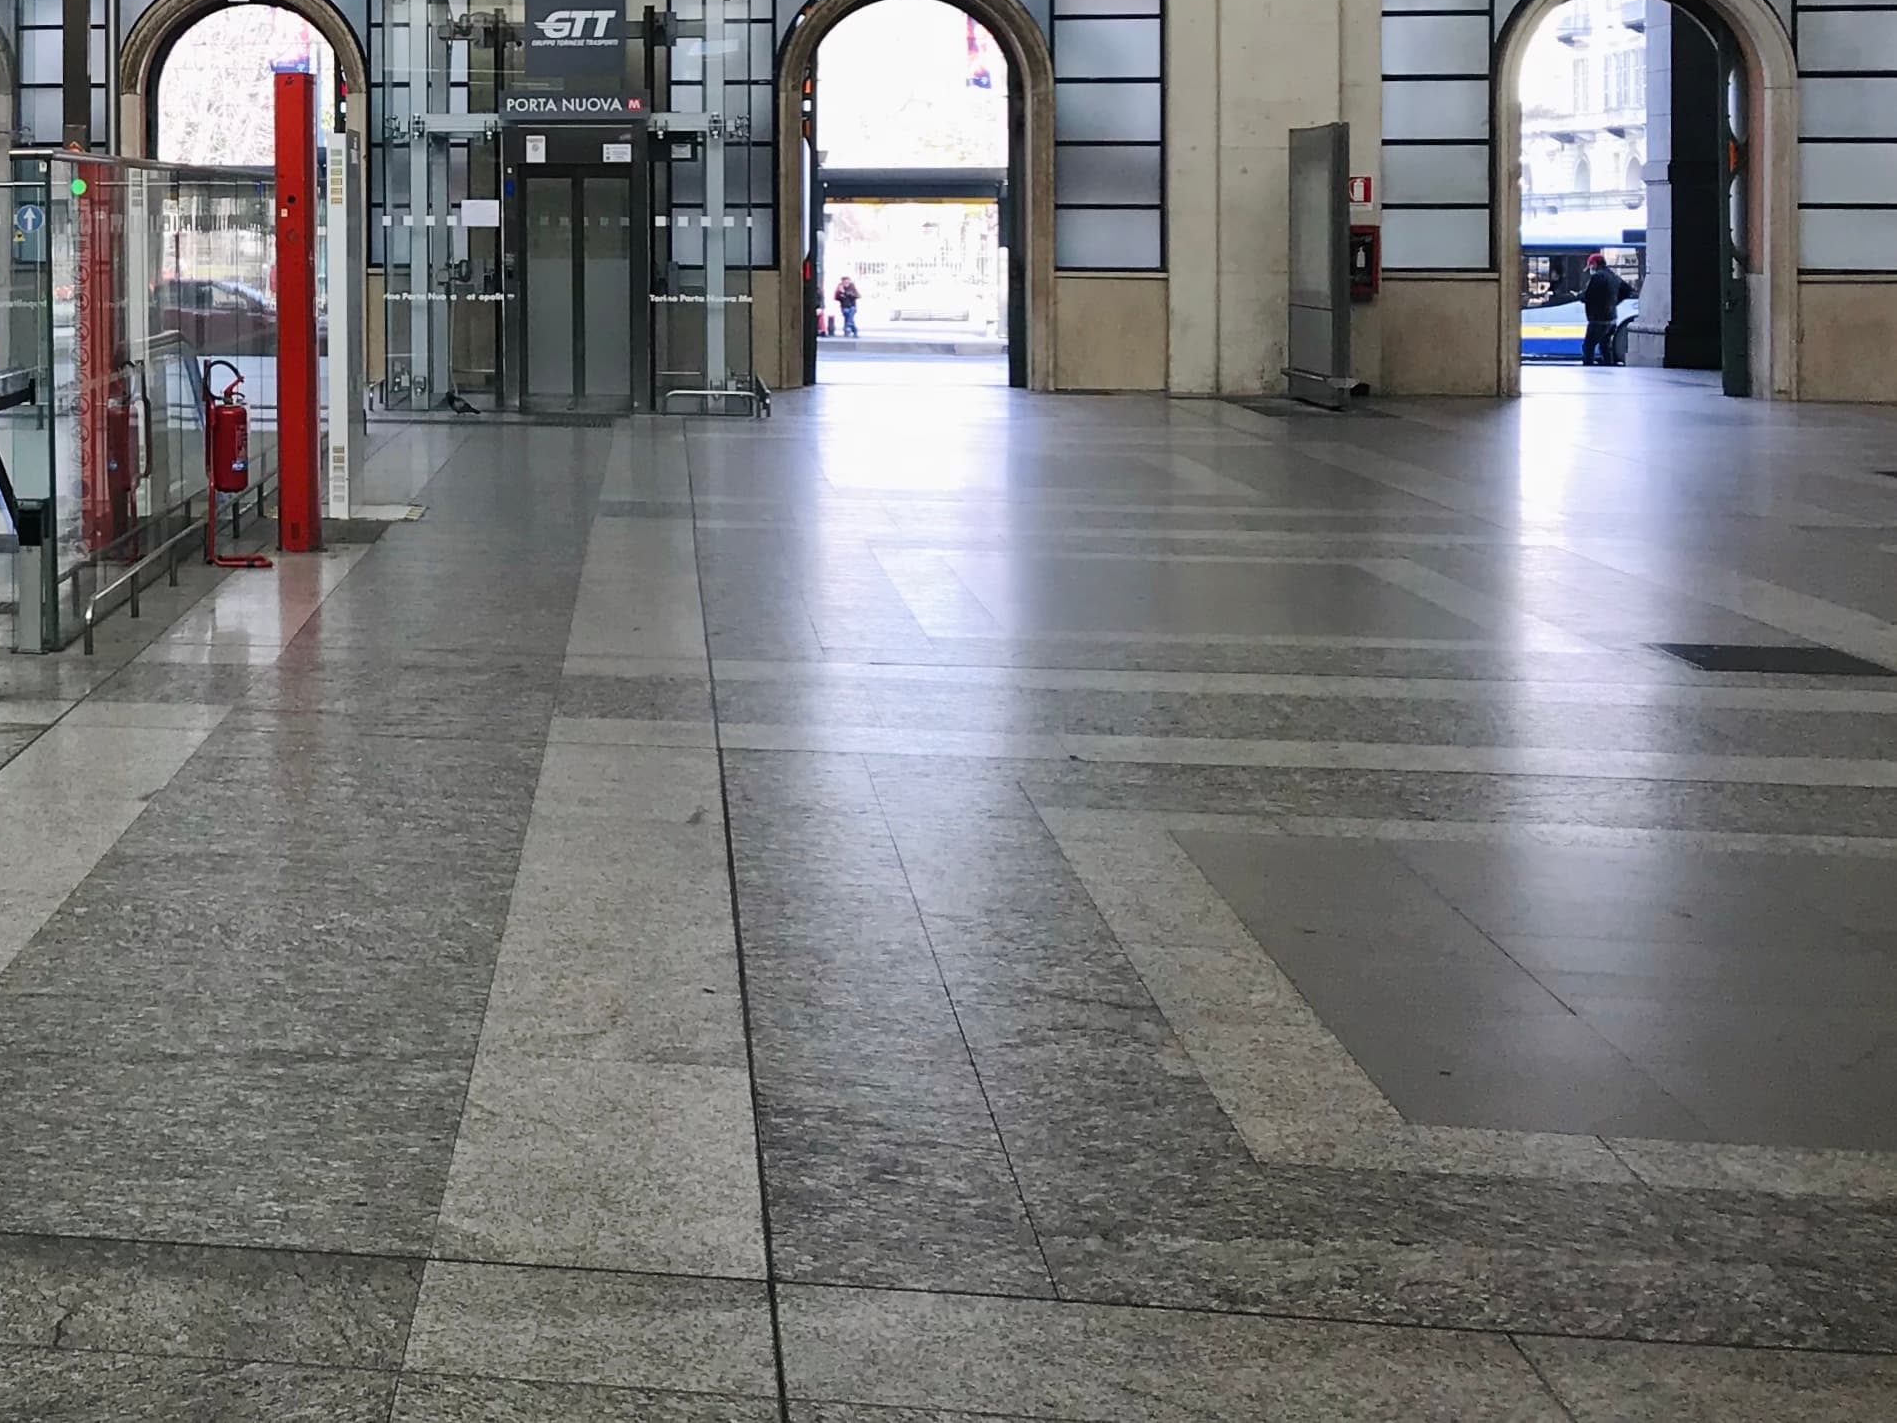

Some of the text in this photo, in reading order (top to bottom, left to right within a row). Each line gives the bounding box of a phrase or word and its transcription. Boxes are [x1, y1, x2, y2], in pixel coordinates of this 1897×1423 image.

[534, 10, 617, 39] GTT
[506, 97, 641, 112] PORTA NUOVA M
